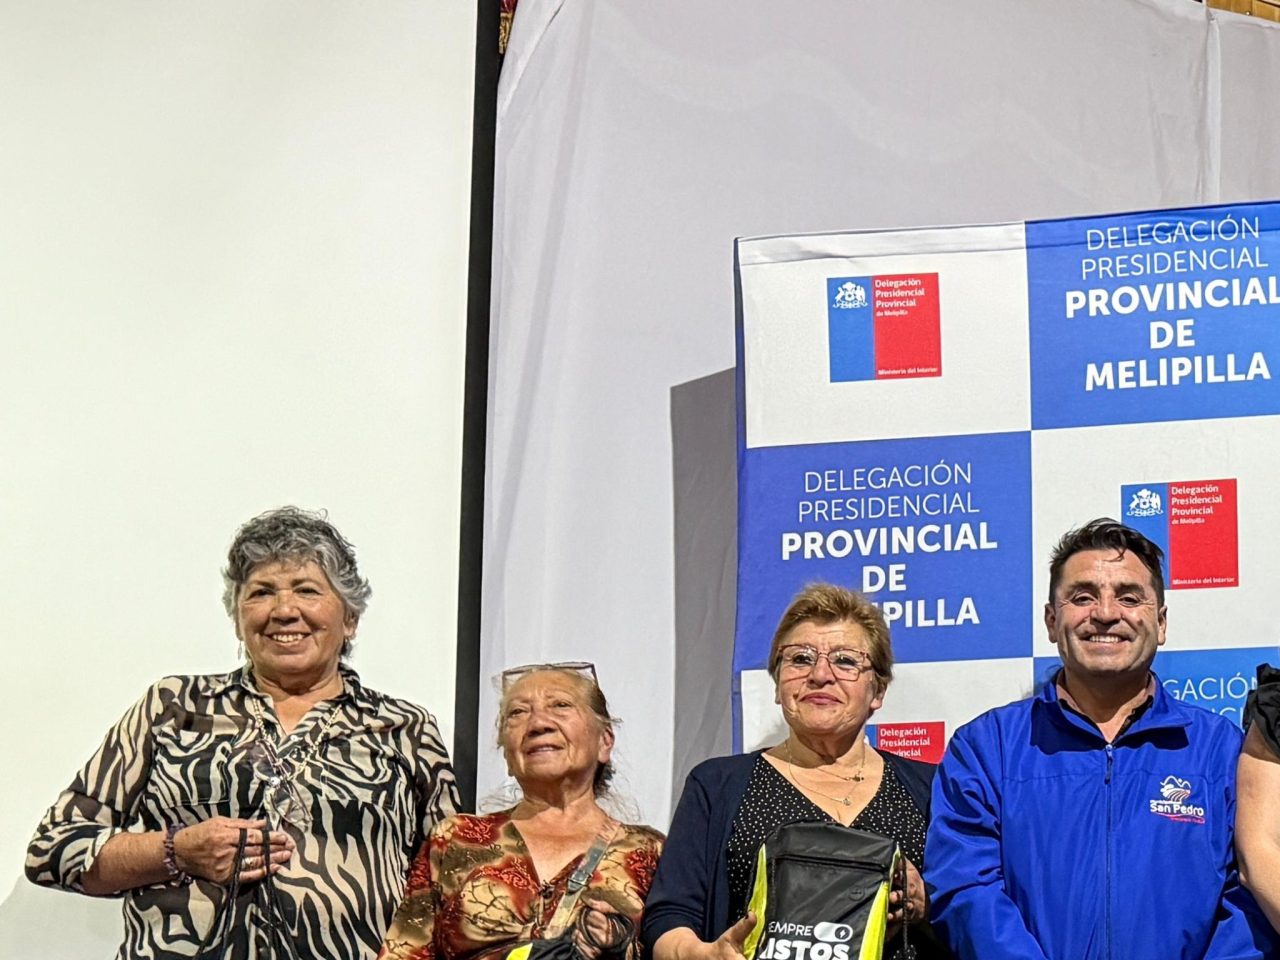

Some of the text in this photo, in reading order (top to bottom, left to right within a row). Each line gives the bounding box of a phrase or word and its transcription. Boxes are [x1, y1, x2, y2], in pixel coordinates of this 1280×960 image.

[1085, 214, 1259, 252] DELEGACIÓN
[1081, 244, 1268, 281] PRESIDENCIAL
[875, 278, 921, 289] Delegación
[875, 288, 925, 298] Presidencial
[876, 299, 916, 308] Provincial
[1149, 319, 1196, 349] DE
[1085, 352, 1271, 392] MELIPILLA
[804, 459, 972, 493] DELEGACIÓN
[1171, 484, 1218, 495] Delegación
[799, 492, 980, 522] PRESIDENCIAL
[1172, 495, 1222, 505] Presidencial
[1172, 506, 1213, 515] Provincial
[781, 521, 998, 560] PROVINCIAL
[862, 563, 907, 593] DE
[876, 597, 980, 629] PILLA
[880, 727, 926, 738] Delegación
[880, 737, 930, 747] Presidencial
[1150, 803, 1204, 817] San Pedro
[768, 921, 814, 936] EMPRE
